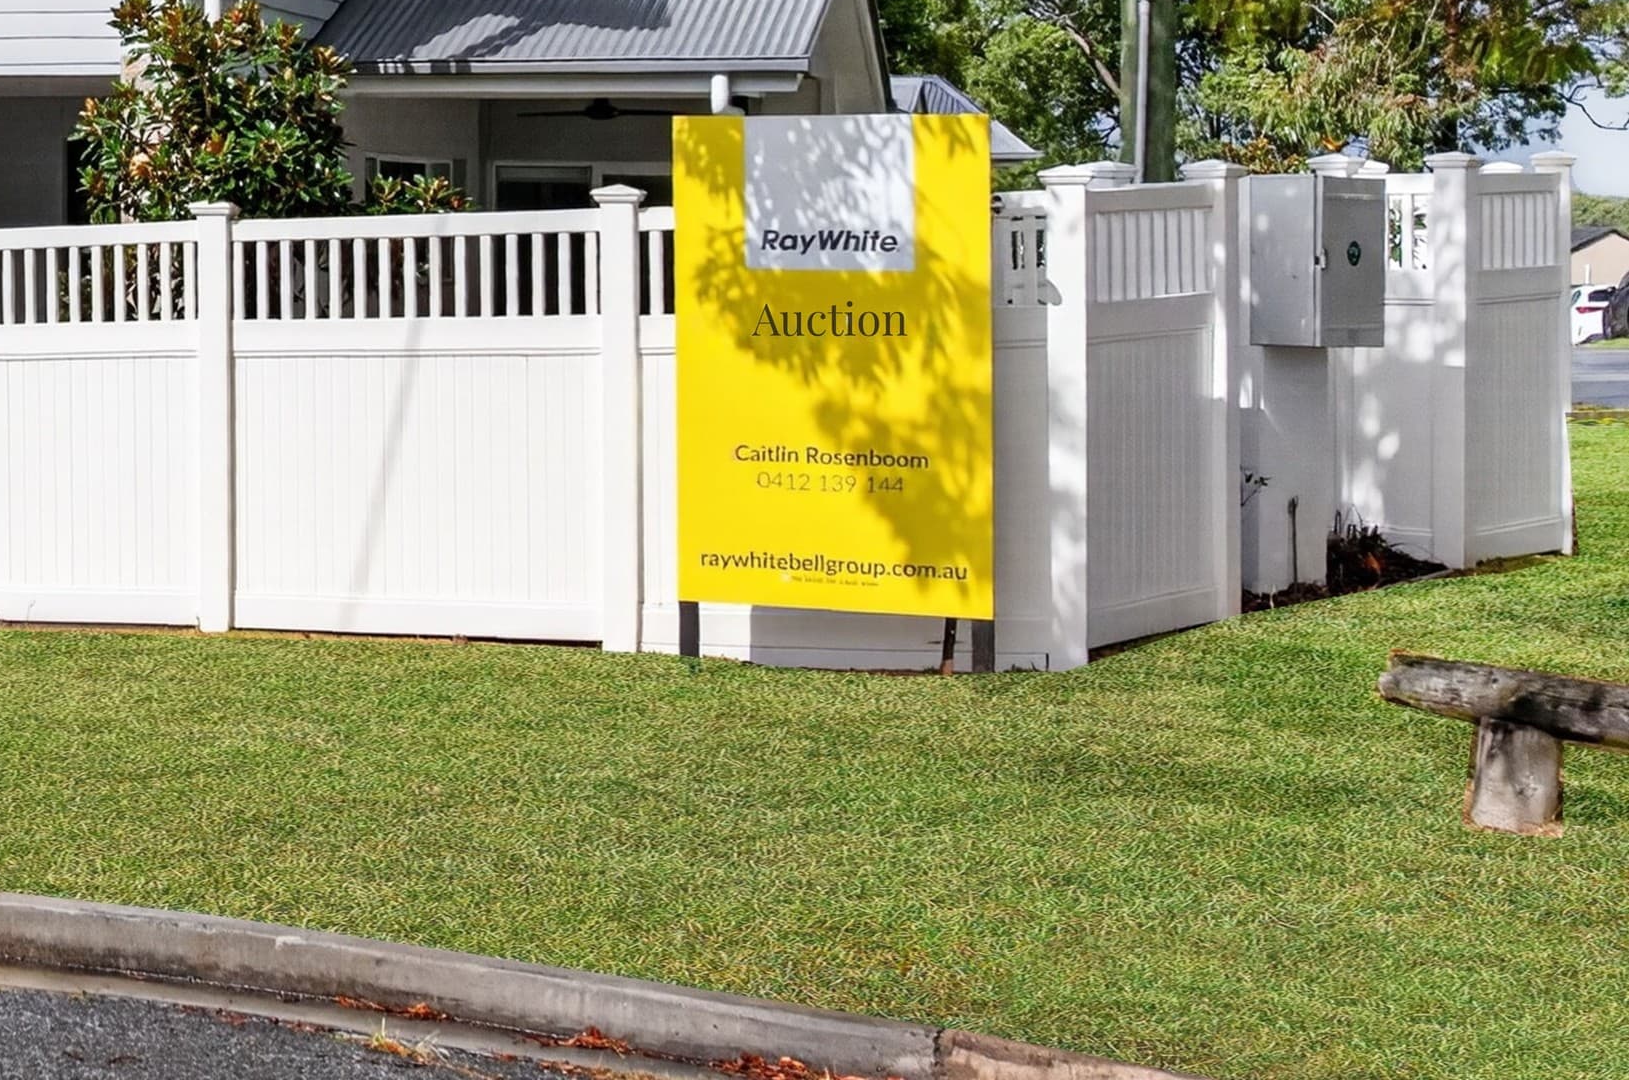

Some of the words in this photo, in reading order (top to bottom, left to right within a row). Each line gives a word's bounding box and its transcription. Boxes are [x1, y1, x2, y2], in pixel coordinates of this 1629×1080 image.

[751, 301, 908, 337] Auction
[735, 444, 799, 463] Caitlin
[806, 446, 929, 469] Rosenboom
[756, 471, 811, 491] 0412
[821, 474, 857, 493] 139
[867, 476, 904, 494] 144
[700, 551, 969, 581] raywhitebellgroup.com.au
